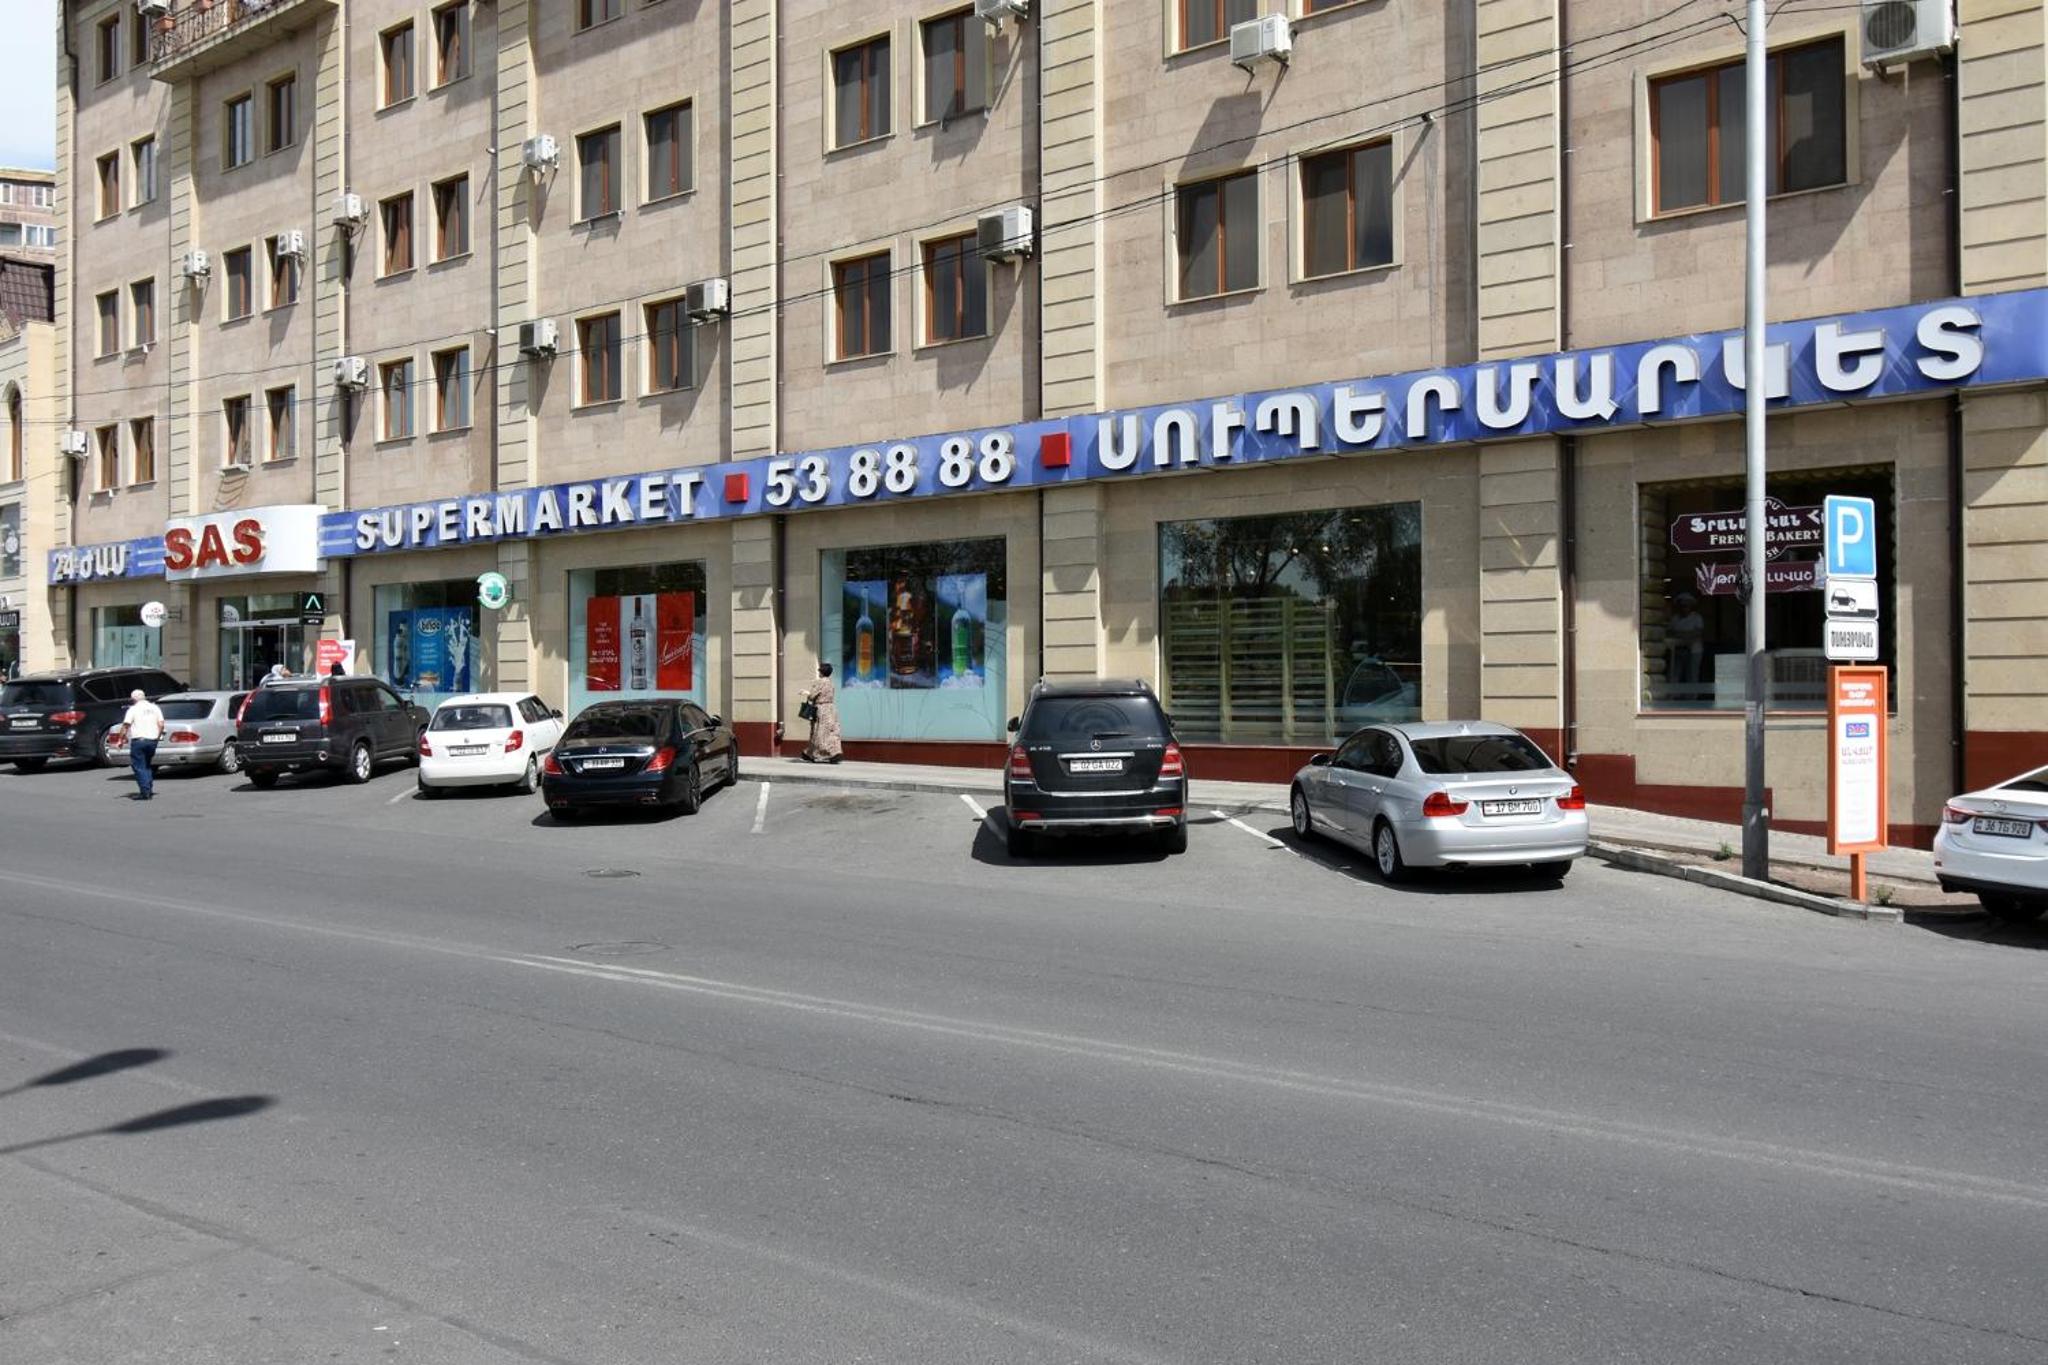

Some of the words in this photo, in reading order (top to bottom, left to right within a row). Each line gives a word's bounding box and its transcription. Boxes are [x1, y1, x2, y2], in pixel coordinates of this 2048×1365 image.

[766, 456, 829, 506] 53
[849, 444, 919, 498] 88
[938, 431, 1016, 487] 88
[356, 472, 702, 550] SUPERMARKET
[1766, 528, 1821, 542] BAKERY
[1837, 506, 1864, 567] P
[164, 519, 264, 571] SAS
